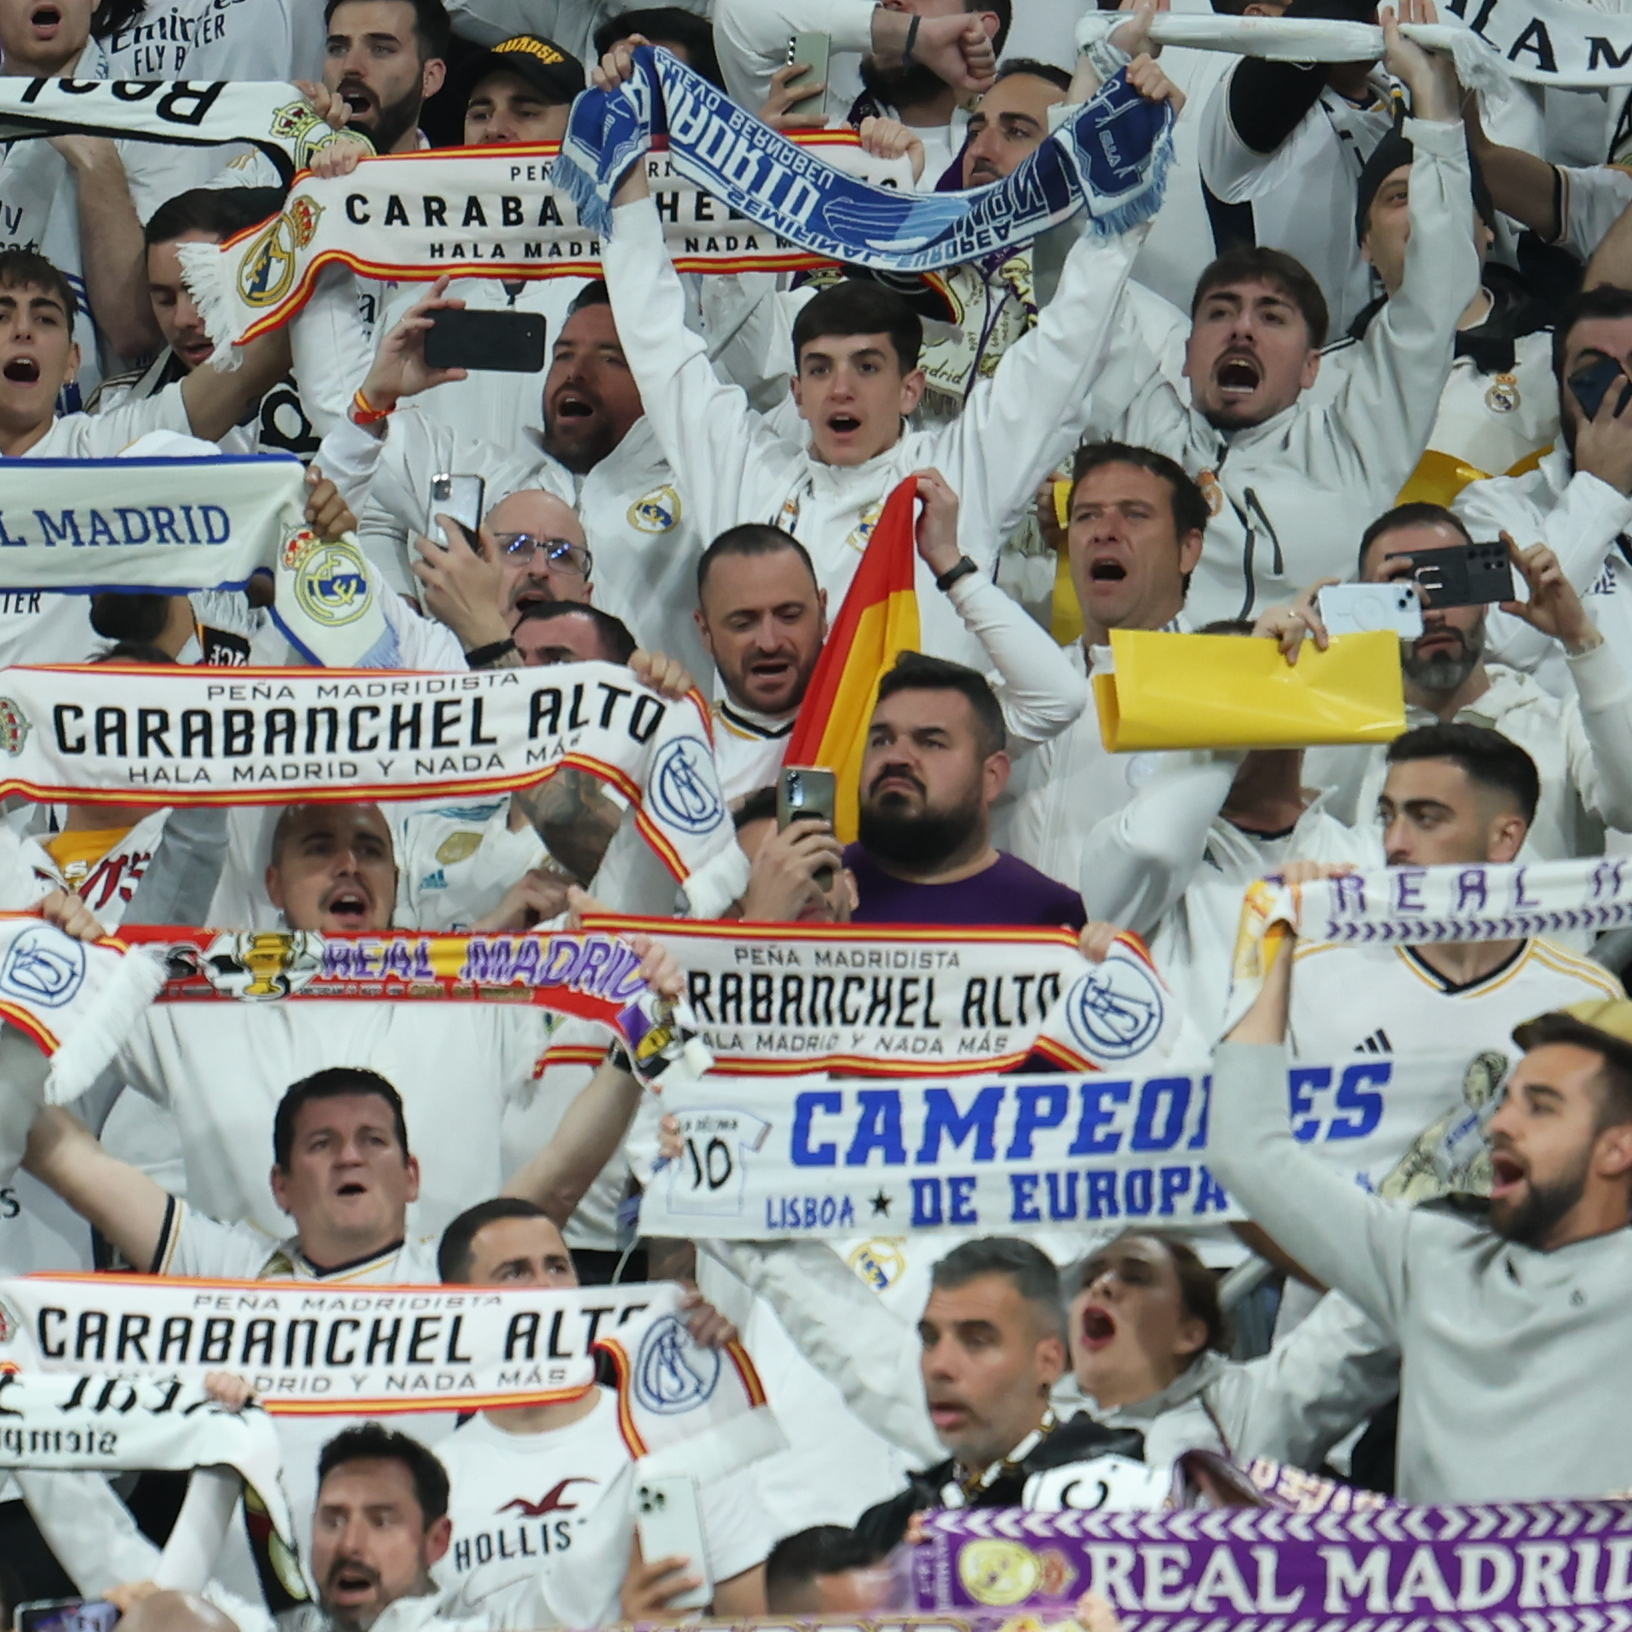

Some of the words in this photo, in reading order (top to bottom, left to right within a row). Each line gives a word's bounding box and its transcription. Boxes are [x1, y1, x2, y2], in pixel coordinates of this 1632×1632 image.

[429, 243, 507, 260] HALA
[685, 235, 759, 254] NADA
[32, 505, 232, 550] MADRID
[207, 680, 302, 702] PEÑA
[317, 670, 519, 698] MADRIDISTA
[52, 698, 484, 760] CARABANCHEL
[529, 681, 666, 747] ALTO
[127, 764, 211, 785] HALA
[234, 759, 361, 782] MADRID
[413, 753, 505, 777] NADA
[323, 941, 435, 980] REAL
[733, 942, 804, 968] PEÑA
[813, 946, 962, 970] MADRIDISTA
[687, 1135, 734, 1194] 10
[765, 1193, 856, 1231] LISBOA
[910, 1172, 977, 1227] DE
[192, 1291, 282, 1313] PEÑA
[299, 1291, 504, 1313] MADRIDISTA
[38, 1305, 473, 1368] CARABANCHEL
[383, 1370, 477, 1395] NADA
[1083, 1540, 1306, 1617] REAL
